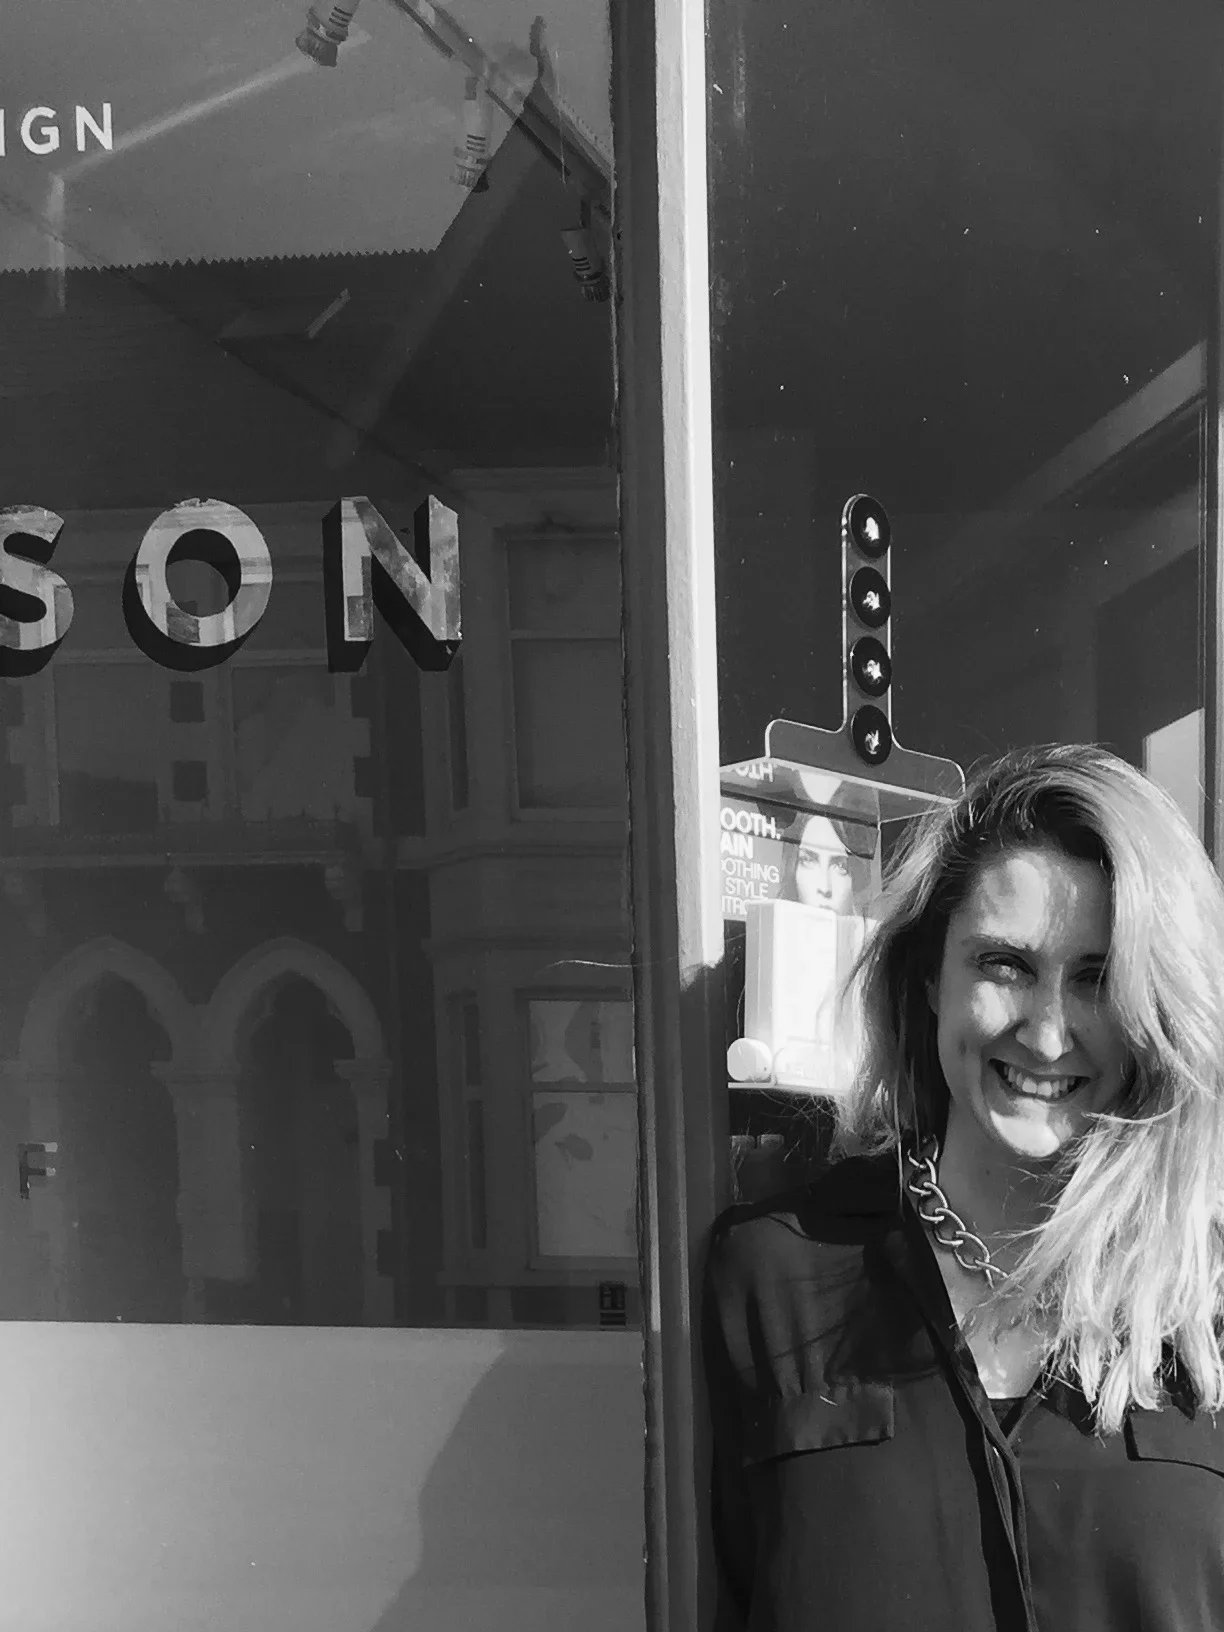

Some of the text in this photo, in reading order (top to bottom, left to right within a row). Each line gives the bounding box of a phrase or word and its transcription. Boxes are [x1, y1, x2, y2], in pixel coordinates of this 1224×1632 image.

[0, 102, 113, 156] IGN
[0, 495, 463, 674] SON
[720, 857, 780, 884] OTHING
[726, 876, 769, 900] STYLE
